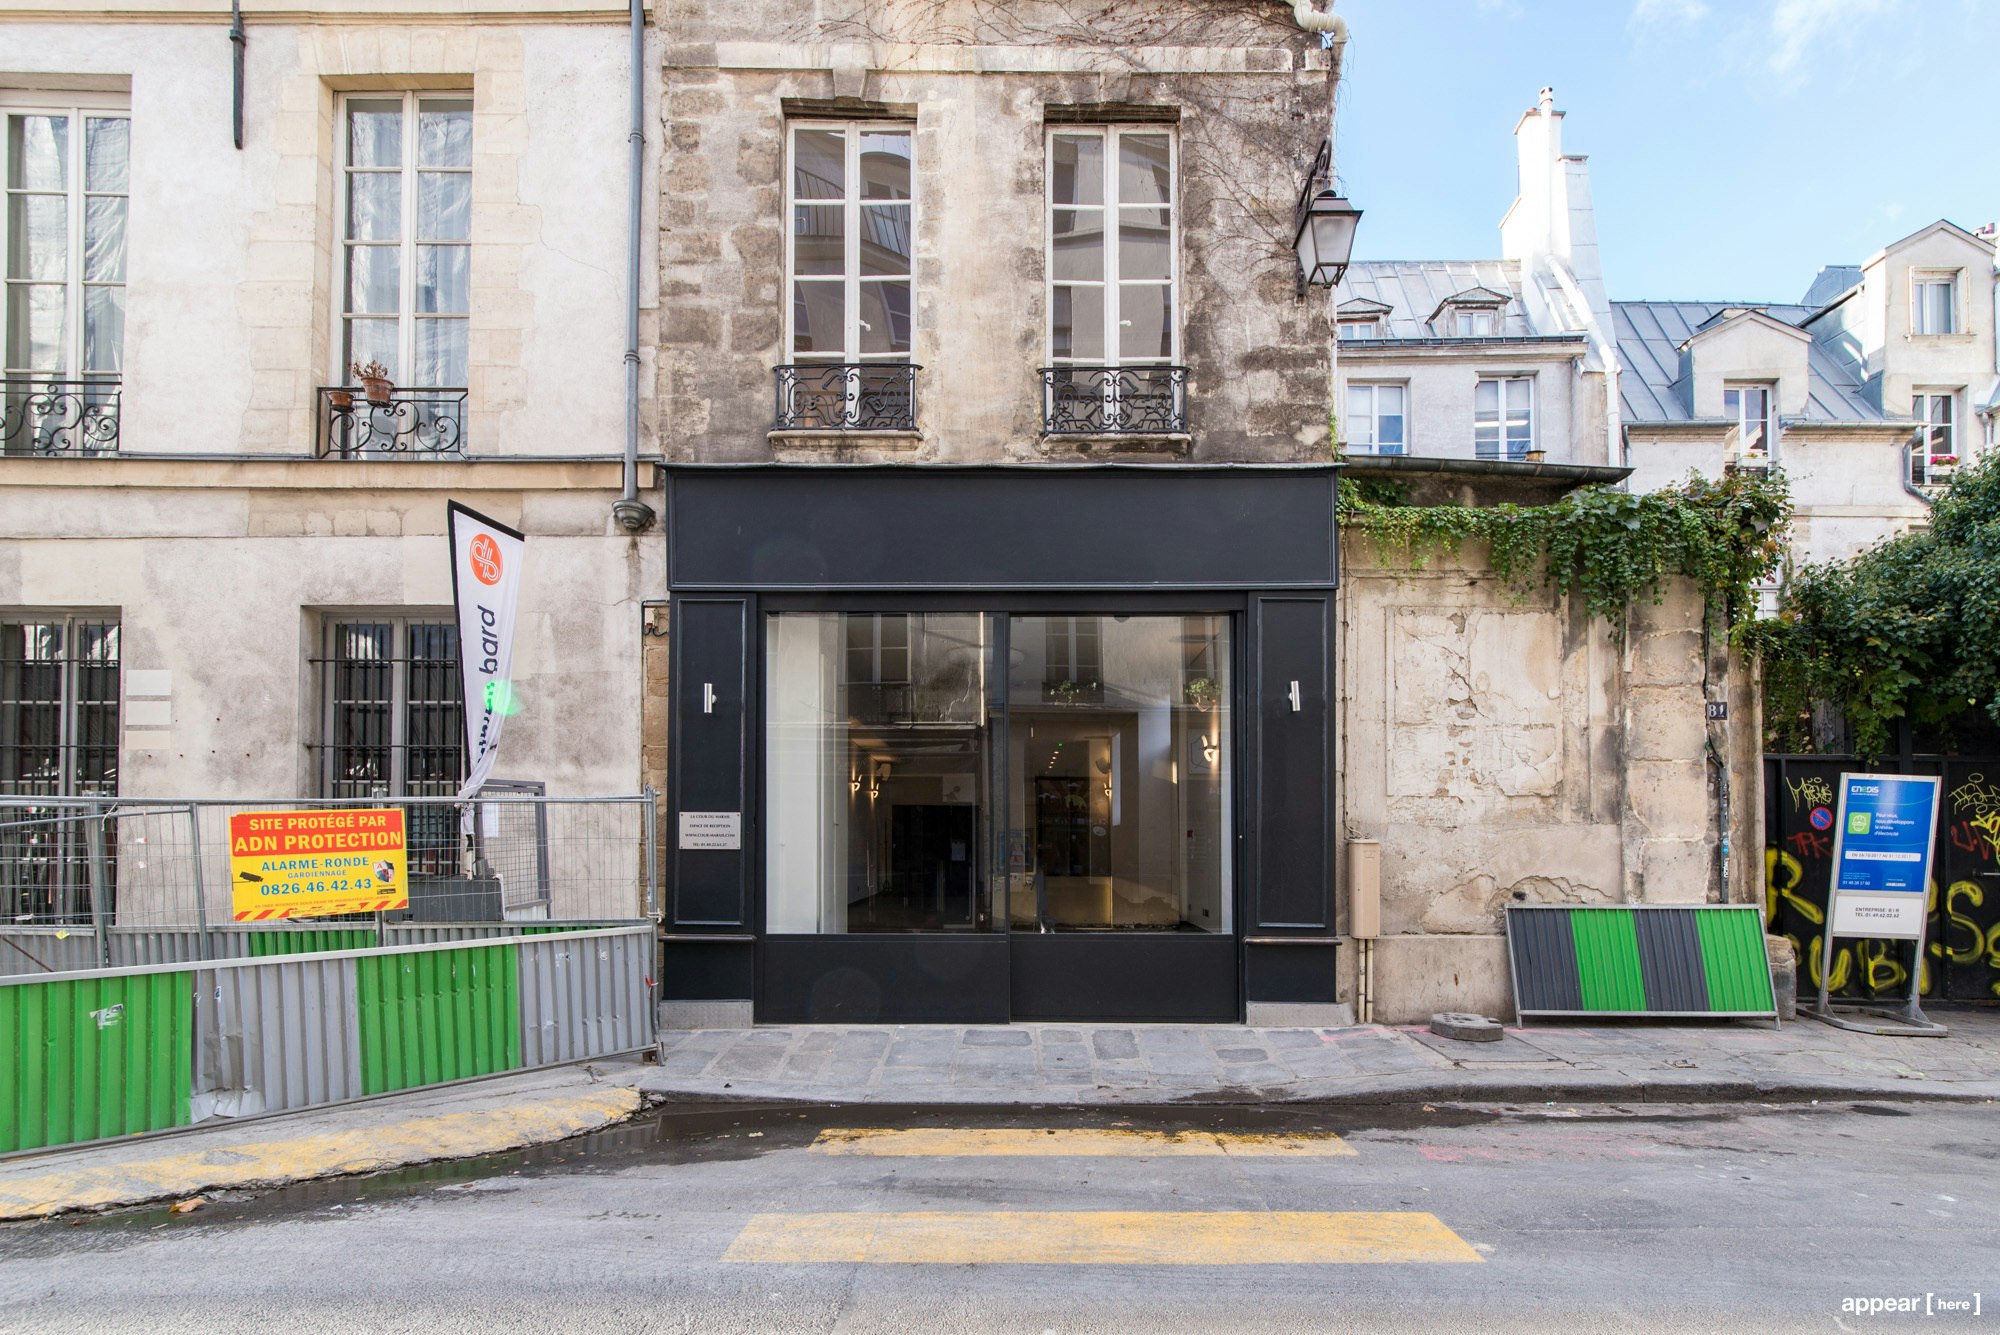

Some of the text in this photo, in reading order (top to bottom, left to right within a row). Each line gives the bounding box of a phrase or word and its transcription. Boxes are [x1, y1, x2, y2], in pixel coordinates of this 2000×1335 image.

[249, 814, 386, 830] SITE PROTÉGÉ PAR
[234, 831, 401, 852] ADN PROTECTION
[261, 856, 370, 871] ALARME-RONDE
[287, 869, 347, 879] GARDIENNAGE
[261, 878, 372, 896] 0826.46.42.43
